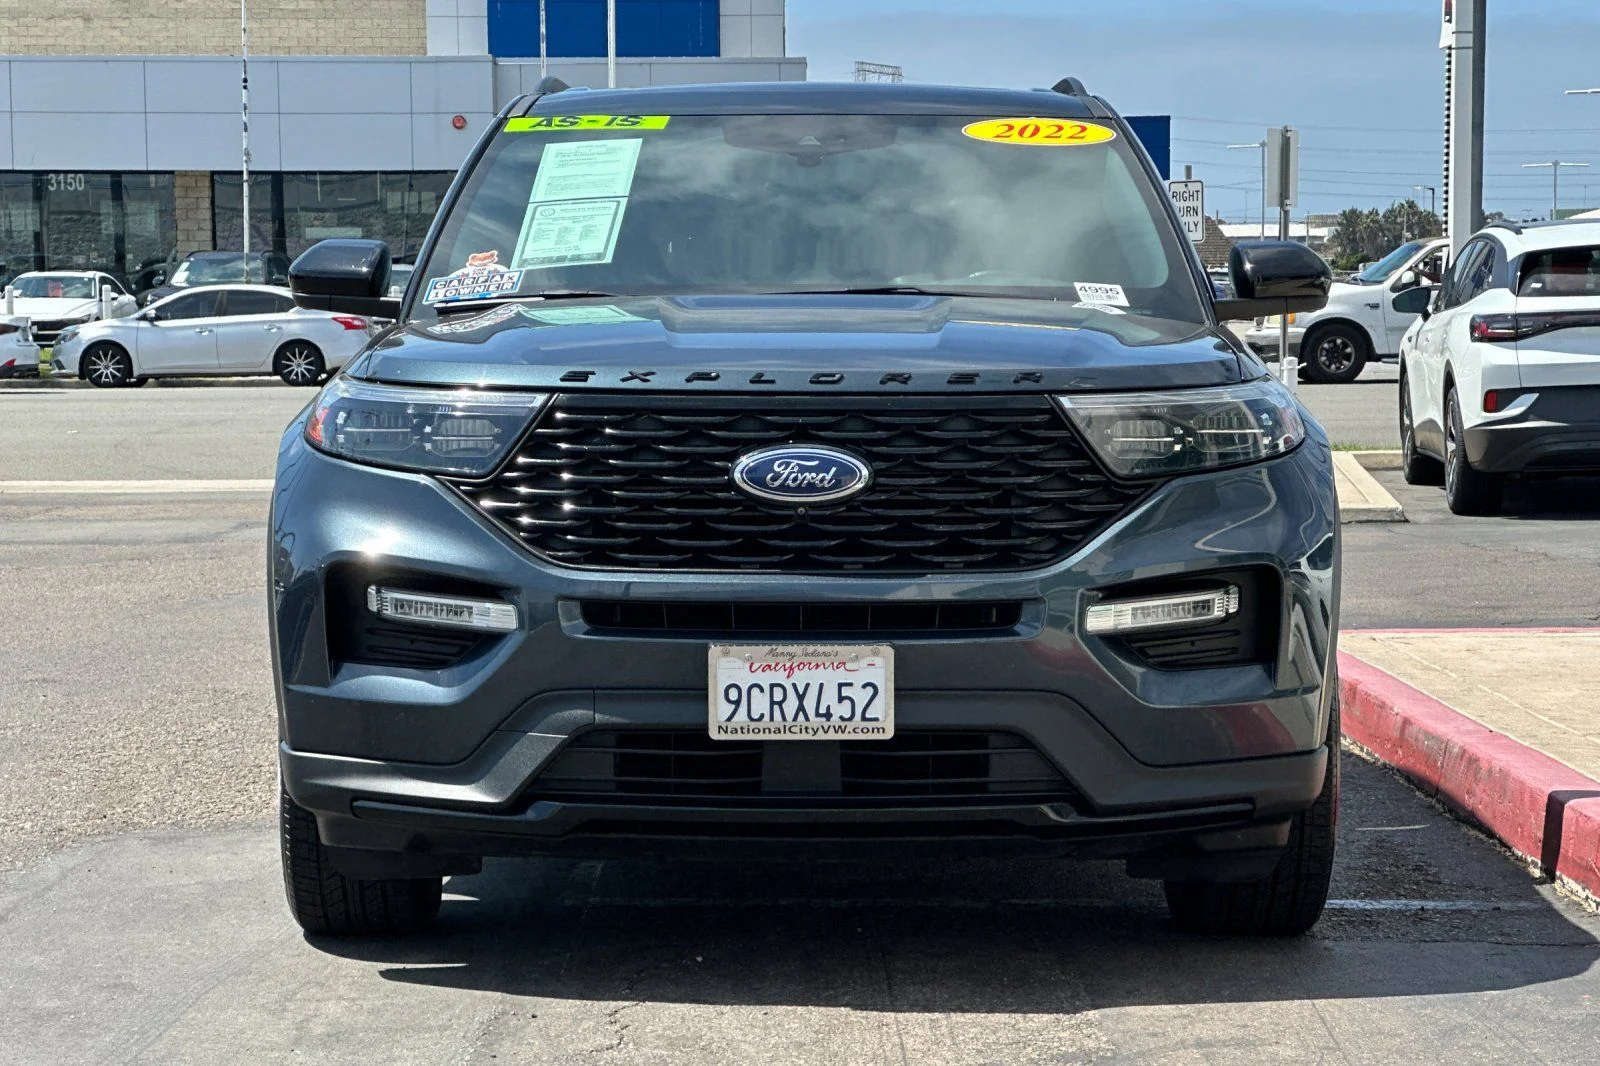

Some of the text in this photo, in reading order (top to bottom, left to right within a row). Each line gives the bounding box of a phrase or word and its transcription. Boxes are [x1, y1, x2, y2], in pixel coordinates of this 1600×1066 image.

[529, 115, 645, 129] AS-IS
[992, 123, 1088, 140] 2022
[47, 173, 85, 191] 3150
[1171, 190, 1200, 202] RIGHT
[1178, 205, 1199, 217] URN
[434, 273, 516, 289] CARFAX
[445, 282, 513, 297] OWNER
[1079, 285, 1120, 296] 4995
[559, 370, 1043, 386] EXPLORER
[766, 459, 837, 488] Ford
[764, 647, 797, 662] Manny
[748, 660, 859, 679] California
[723, 682, 880, 722] 9CRX452
[717, 724, 886, 736] NationalCityVW.com
